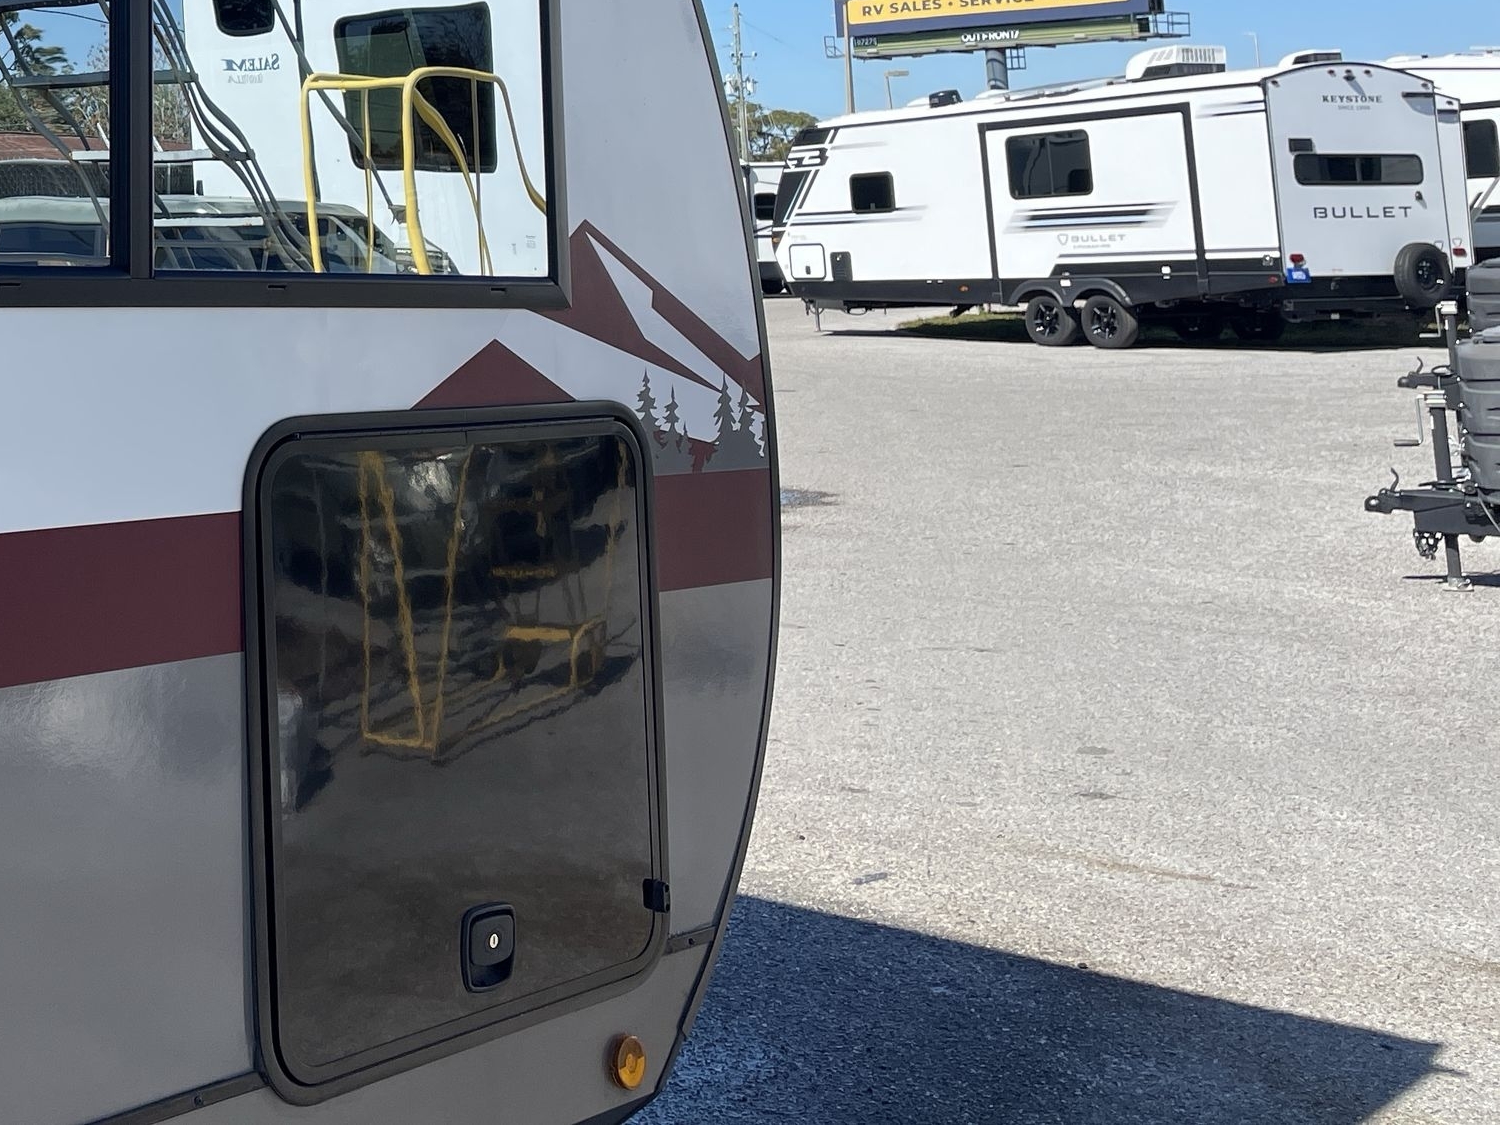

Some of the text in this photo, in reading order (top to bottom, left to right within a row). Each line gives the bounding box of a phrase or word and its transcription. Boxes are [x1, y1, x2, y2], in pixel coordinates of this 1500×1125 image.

[861, 4, 884, 17] RV
[1322, 94, 1383, 104] KEYSTONE
[1313, 206, 1412, 219] BULLET
[1070, 233, 1126, 243] BULLET
